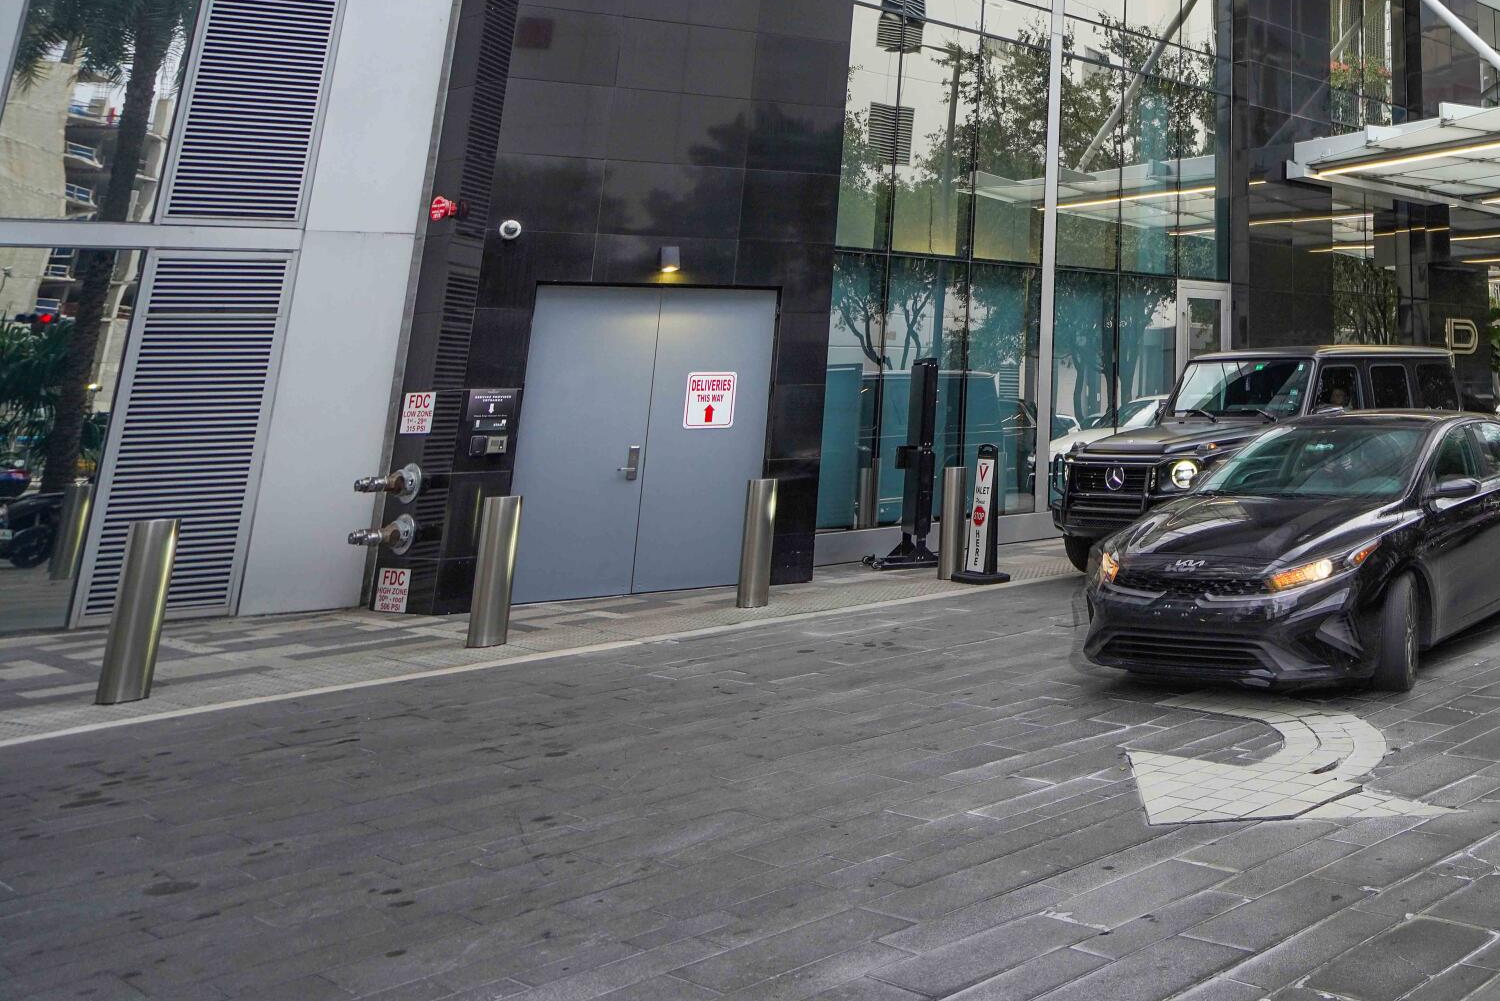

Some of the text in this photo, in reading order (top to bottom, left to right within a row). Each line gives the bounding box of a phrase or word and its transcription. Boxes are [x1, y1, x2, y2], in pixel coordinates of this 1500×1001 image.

[692, 379, 732, 391] DELIVERIES
[408, 394, 431, 409] FDC
[697, 394, 724, 402] THIS WAY
[383, 570, 405, 586] FDC
[391, 587, 407, 596] ZONE
